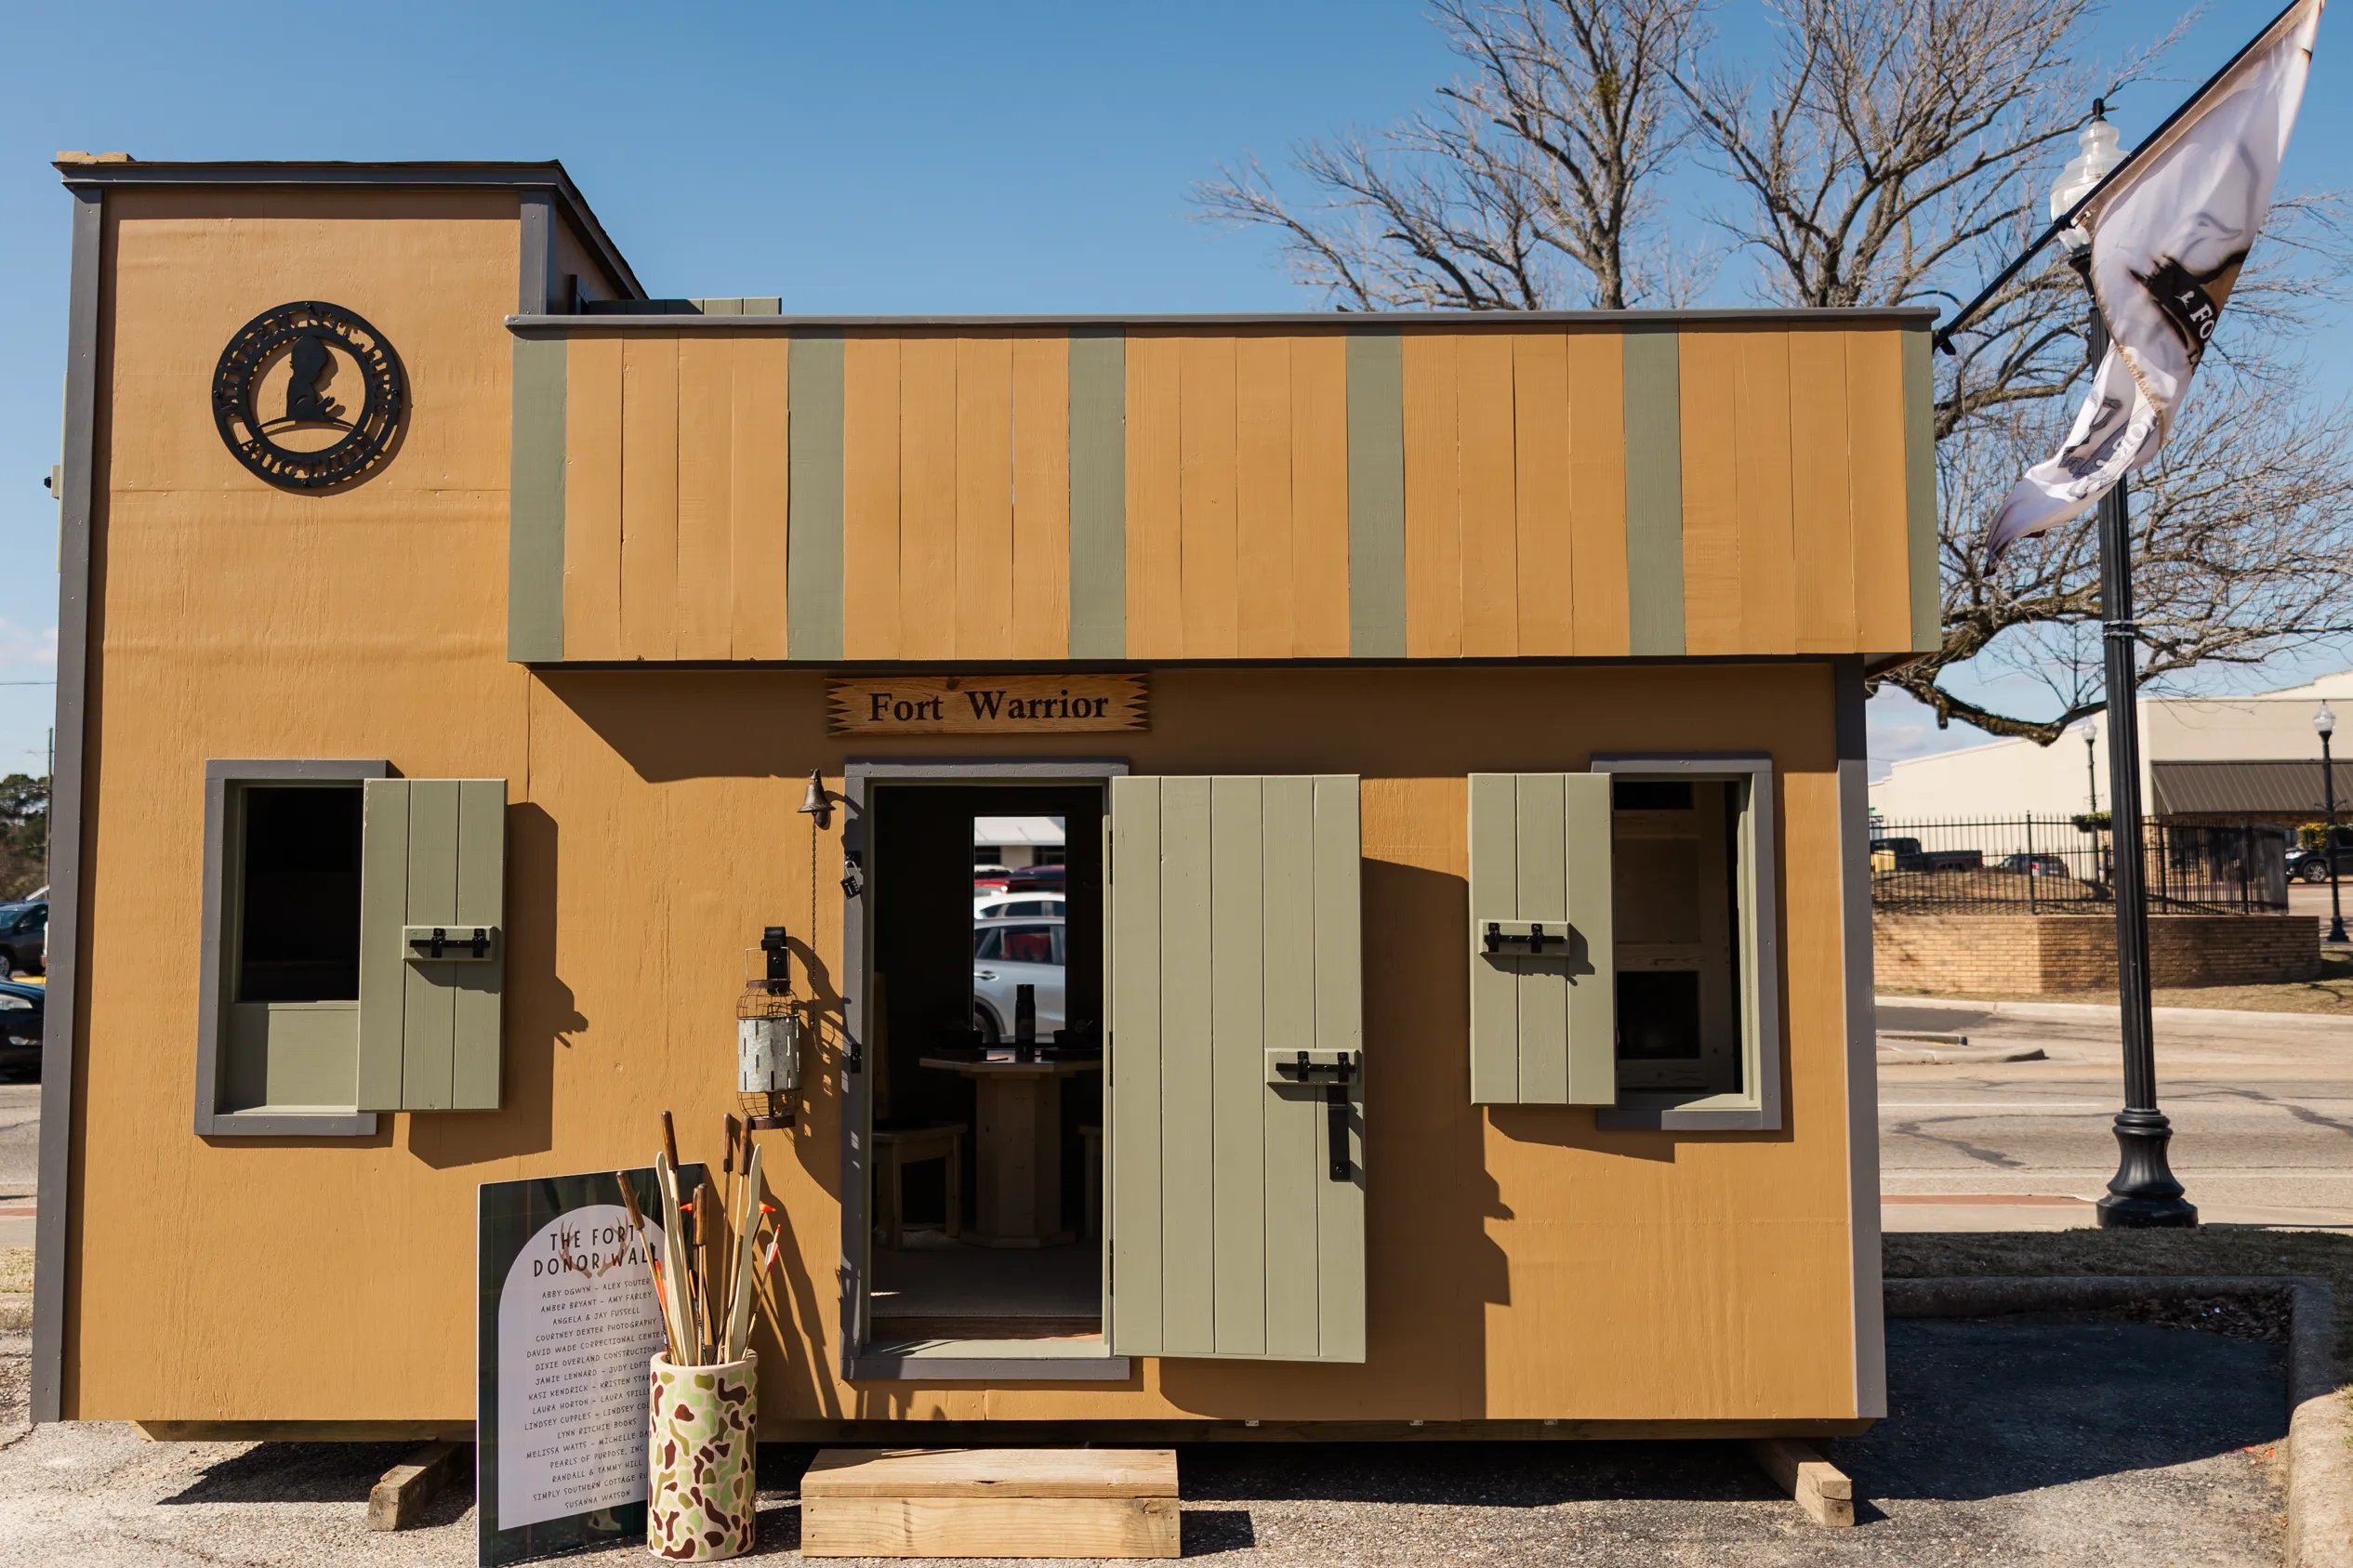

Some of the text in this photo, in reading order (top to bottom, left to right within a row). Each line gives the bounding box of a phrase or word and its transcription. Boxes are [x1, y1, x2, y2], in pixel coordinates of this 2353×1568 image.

[868, 689, 1109, 721] Fort Warrior
[550, 1225, 634, 1250] THE FORT
[535, 1253, 600, 1277] DONOR
[542, 1290, 561, 1298] ABBY
[565, 1285, 591, 1296] OGWYN
[603, 1282, 621, 1290] ALEX
[625, 1278, 651, 1287] SOUTER
[541, 1303, 565, 1313] AMBER
[570, 1299, 597, 1309] BRYANT
[608, 1296, 622, 1304] AMY
[626, 1291, 652, 1300] FARLEY
[553, 1315, 581, 1325] ANGELA
[594, 1311, 607, 1320] JAY
[611, 1307, 641, 1317] FUSSELL
[536, 1318, 657, 1342] COURTNEY DEXTER PHOTOGRAPHY
[527, 1331, 665, 1358] DAVID WADE CORRECTIONAL CENTER
[535, 1346, 657, 1371] DIXIE OVERLAND CONSTRUCTION
[535, 1376, 560, 1385] JAMIE
[564, 1370, 597, 1381] LENNARD
[609, 1364, 627, 1373] JUDY
[529, 1391, 547, 1401] KASI
[550, 1386, 588, 1397] KENDRICK
[601, 1377, 630, 1390] KRISTEN
[634, 1375, 651, 1383] STAR
[533, 1404, 556, 1415] LAURA
[561, 1400, 588, 1409] HORTON
[601, 1393, 623, 1403] LAURA
[525, 1418, 557, 1430] LINDSEY
[561, 1412, 591, 1424] CUPPLES
[603, 1404, 634, 1416] LINDSEY
[558, 1418, 637, 1439] LYNN RITCHIE BOOKS
[527, 1447, 559, 1458] MELISSA
[563, 1442, 587, 1452] WATTS
[599, 1432, 636, 1445] MICHELLE
[550, 1458, 576, 1469] PEARLS
[594, 1449, 627, 1460] PURPOSE,
[630, 1444, 643, 1454] INC
[552, 1472, 585, 1482] RANDALL
[599, 1463, 622, 1473] TAMMY
[626, 1459, 642, 1469] HILL
[534, 1490, 560, 1501] SIMPLY
[563, 1482, 601, 1495] SOUTHERN
[604, 1474, 636, 1487] COTTAGE
[565, 1490, 630, 1509] SUSANNA WATSON
